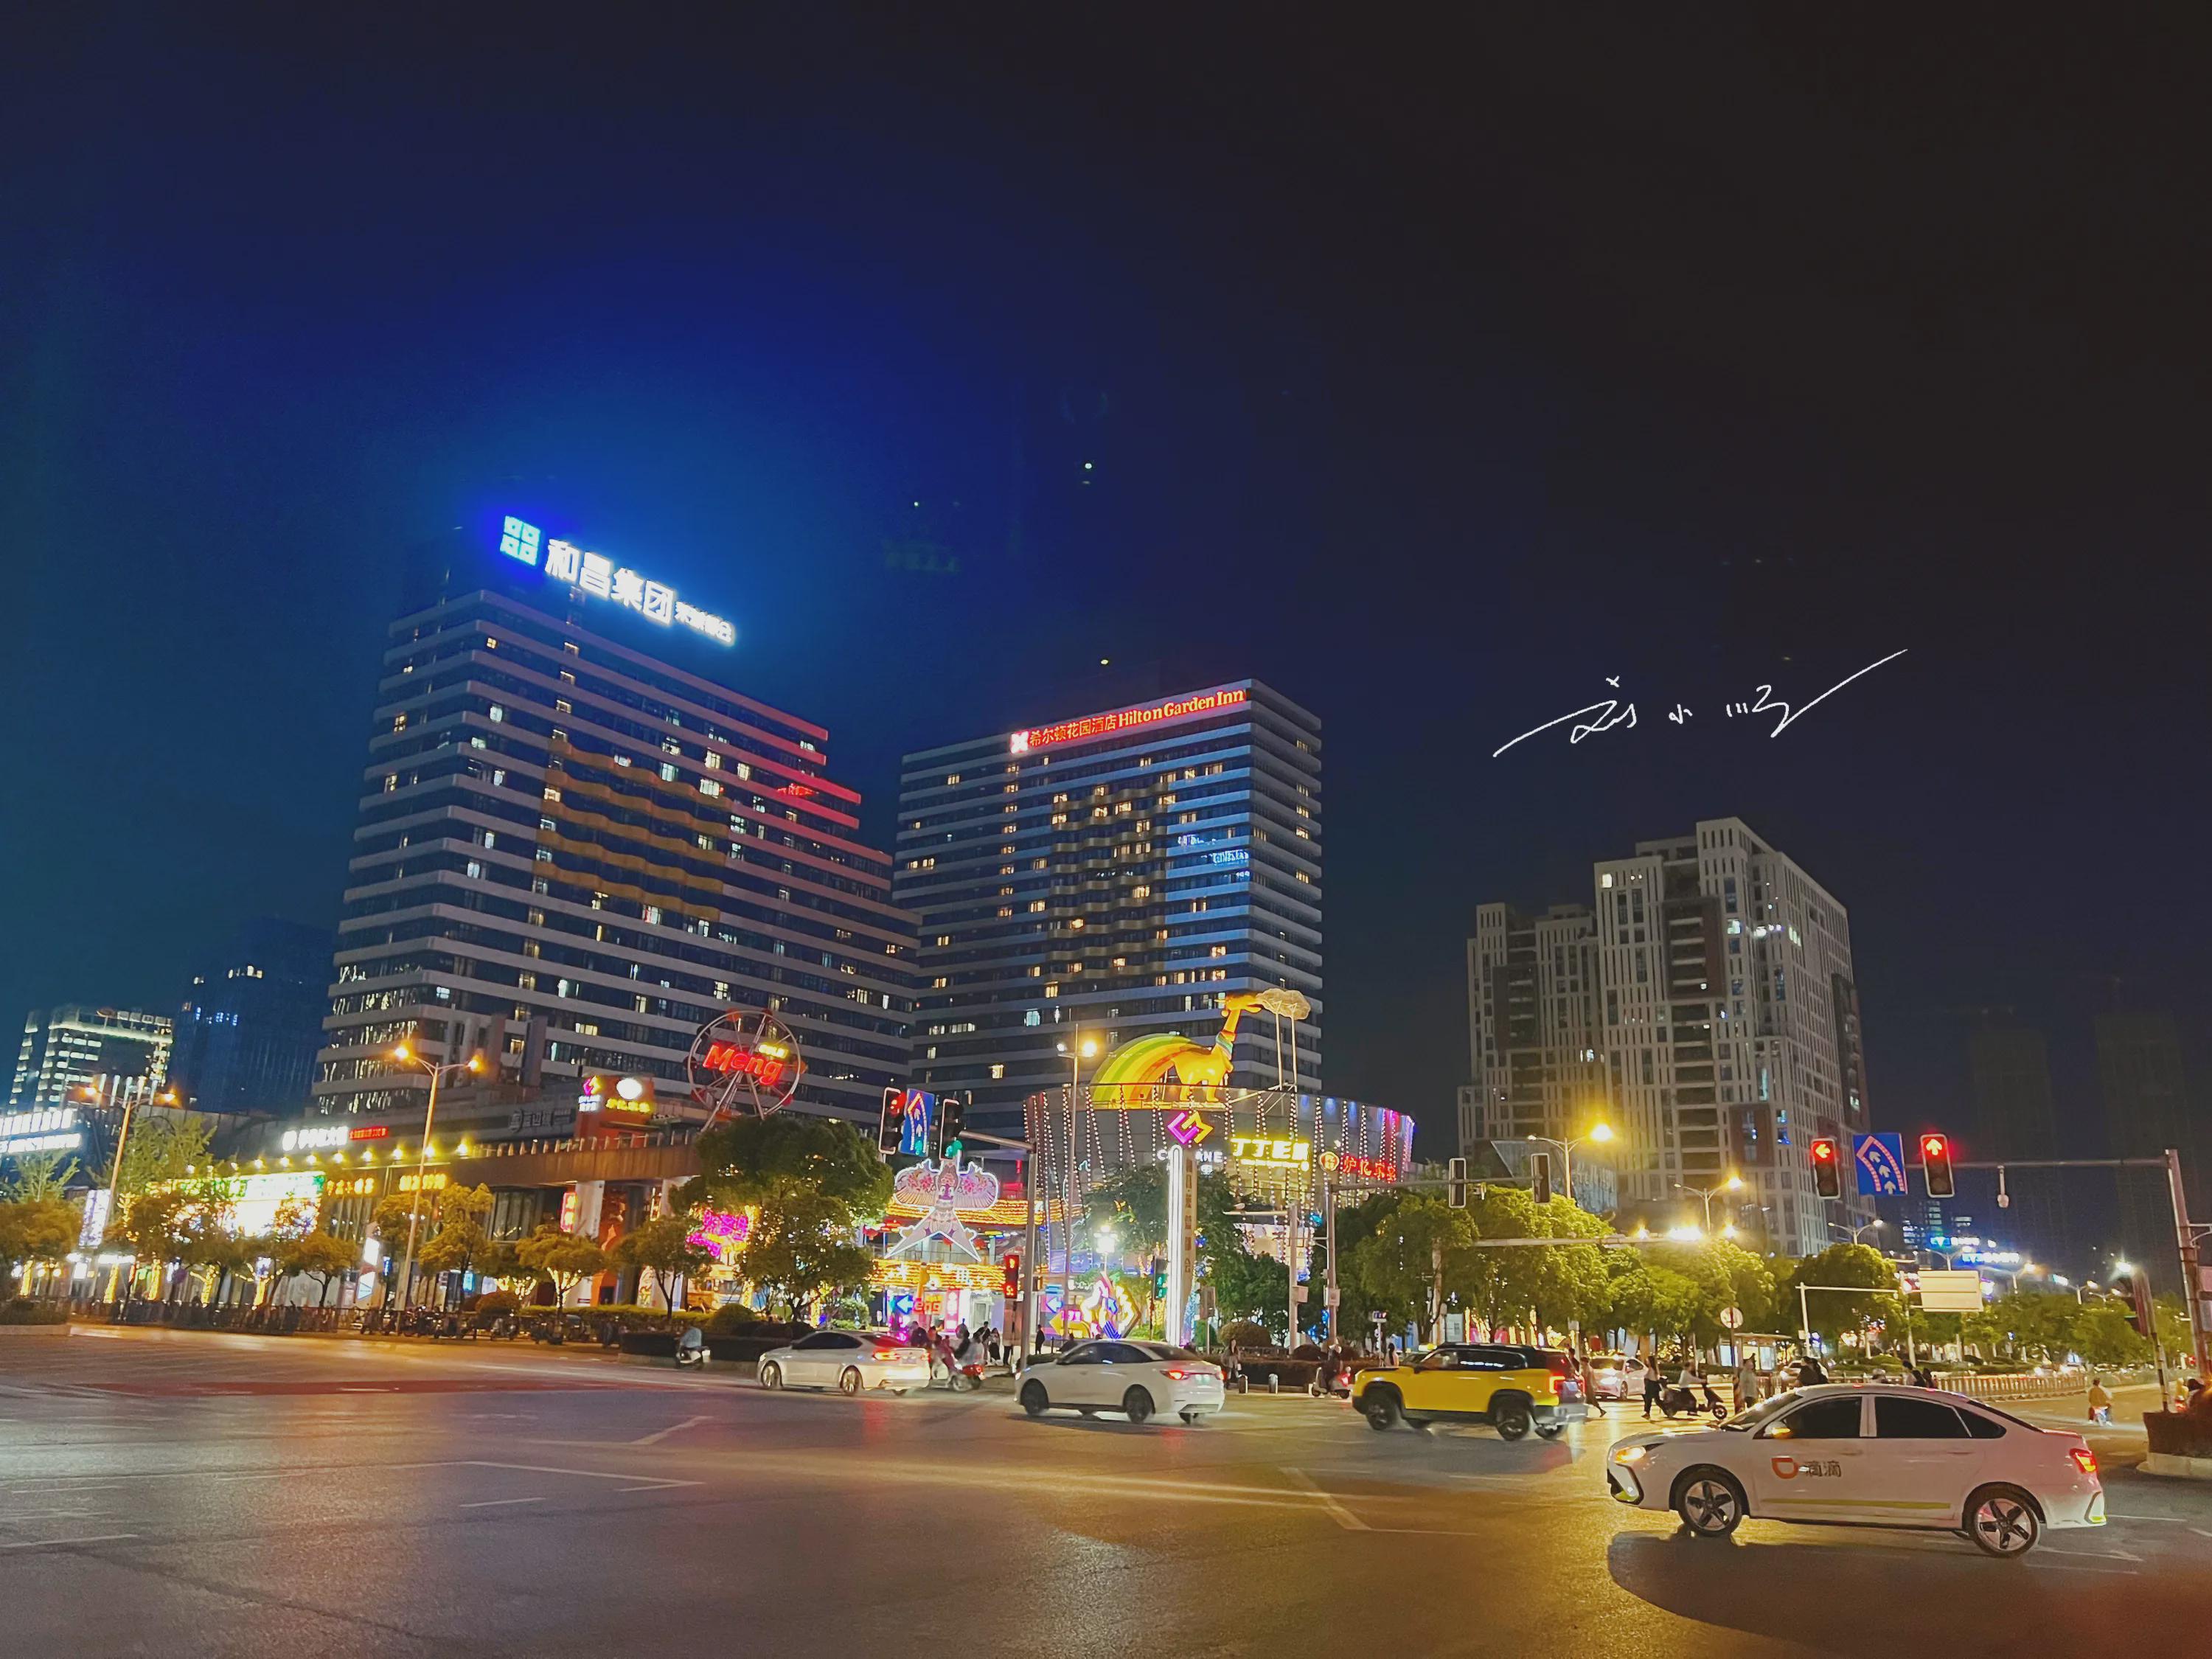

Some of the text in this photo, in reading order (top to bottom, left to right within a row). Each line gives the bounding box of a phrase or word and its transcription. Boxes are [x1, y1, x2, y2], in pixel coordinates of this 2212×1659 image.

[545, 538, 674, 625] 和昌集团
[1119, 689, 1245, 728] Hilton Garden Inn
[1029, 714, 1117, 747] 希尔顿花园酒店
[703, 1044, 783, 1085] Meng
